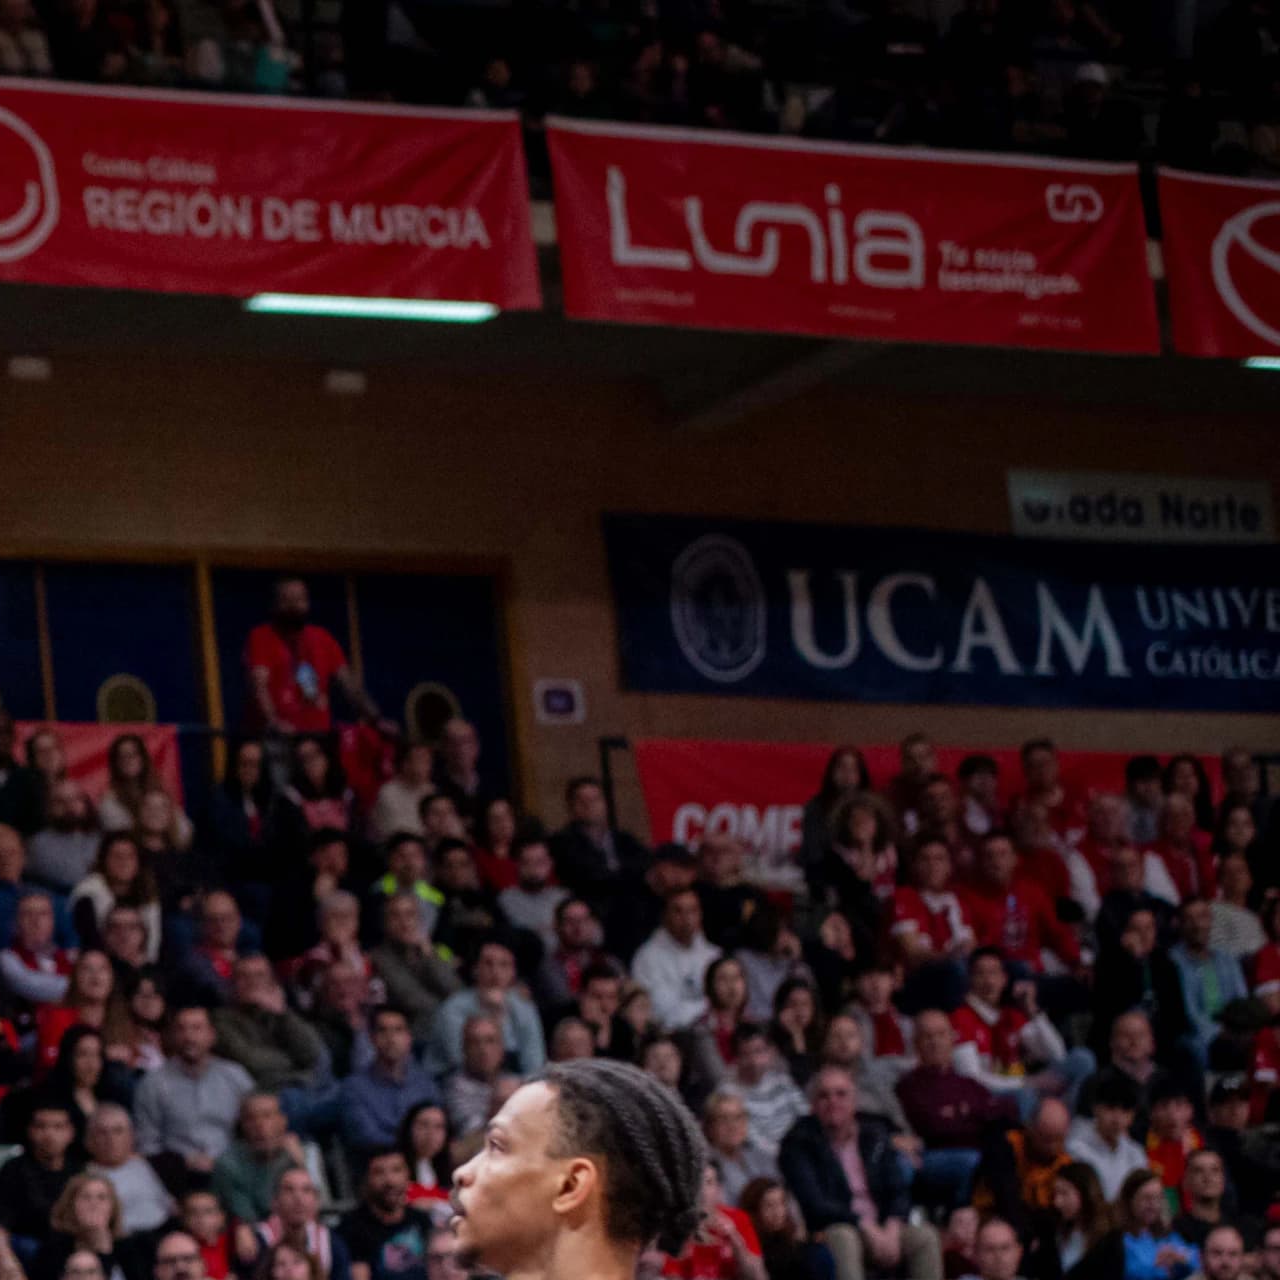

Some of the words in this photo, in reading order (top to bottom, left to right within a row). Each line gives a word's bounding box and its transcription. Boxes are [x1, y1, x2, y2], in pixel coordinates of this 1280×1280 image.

[82, 186, 252, 240] REGIÓN
[262, 197, 322, 243] DE
[330, 197, 491, 249] MURCIA
[786, 567, 1133, 680] UCAM
